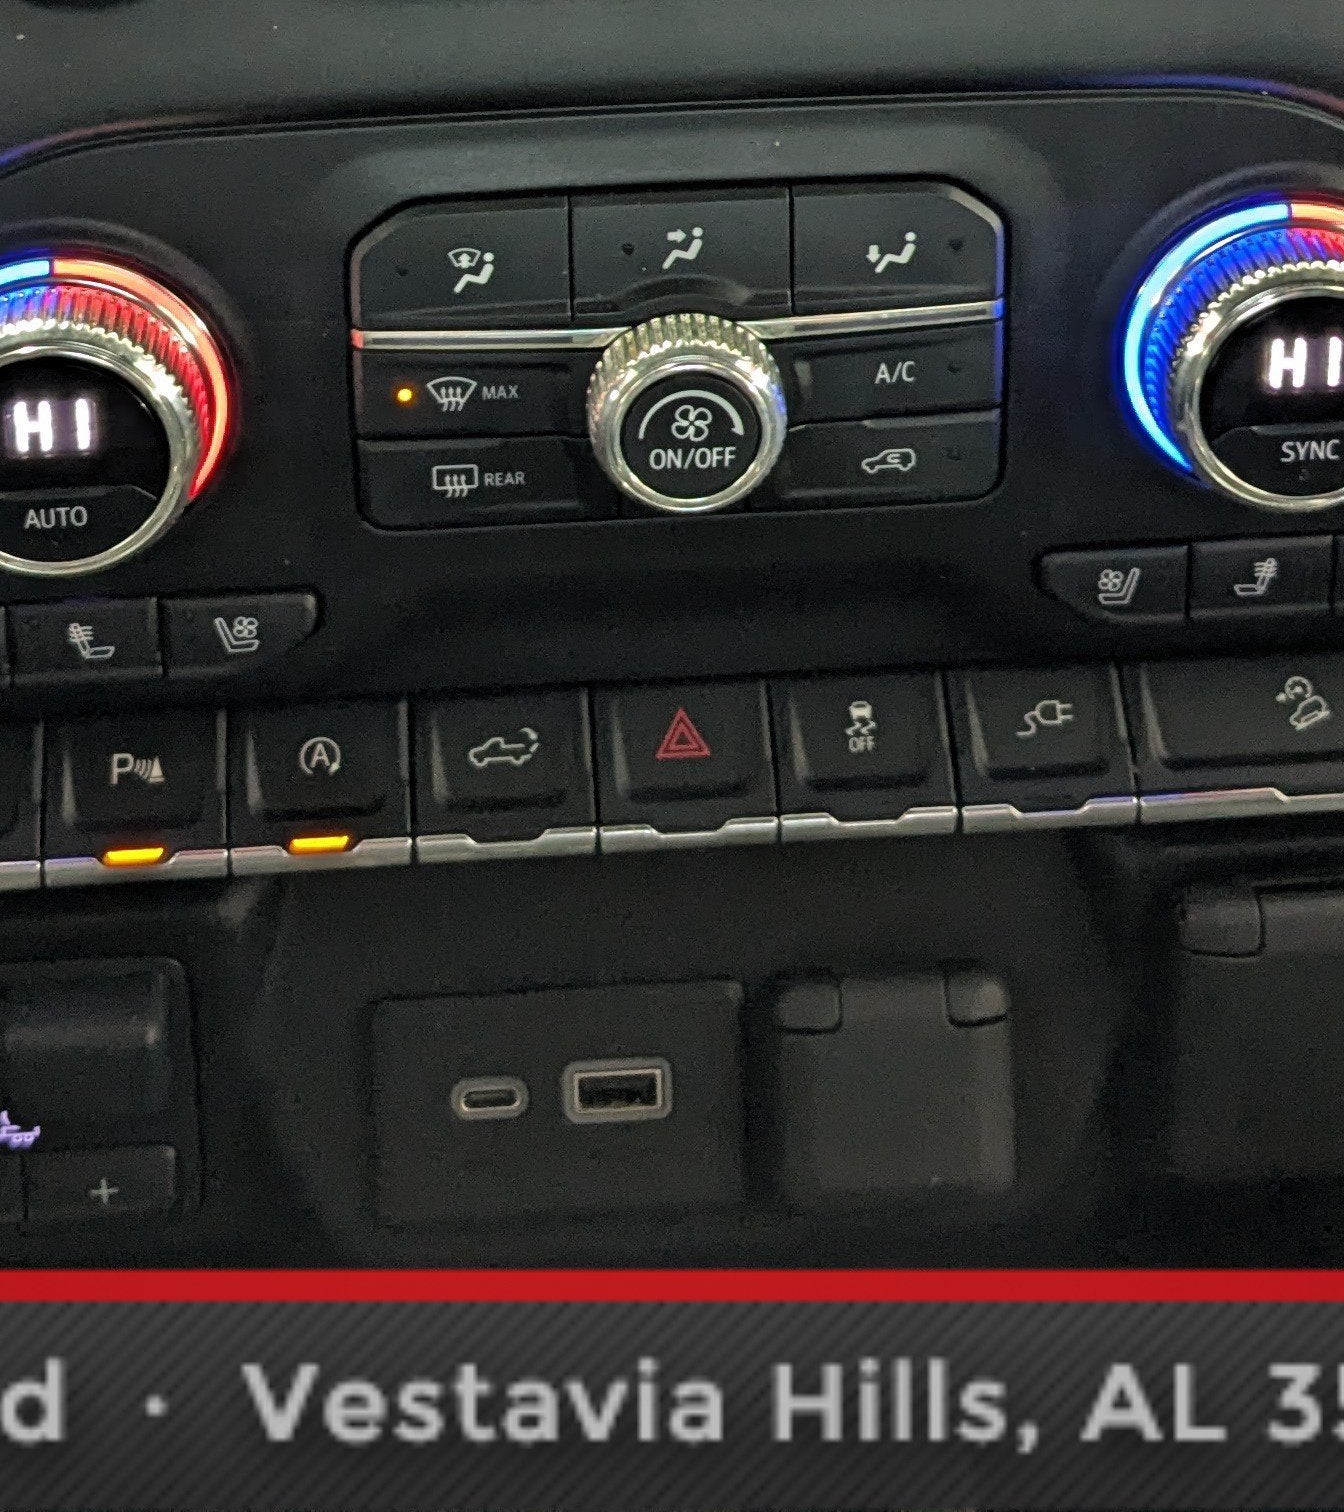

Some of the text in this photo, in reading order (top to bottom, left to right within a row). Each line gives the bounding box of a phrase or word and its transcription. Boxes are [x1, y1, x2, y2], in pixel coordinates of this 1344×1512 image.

[874, 361, 916, 386] A/C
[1268, 335, 1341, 389] HI
[482, 383, 520, 402] MAX
[11, 397, 93, 453] HI
[648, 446, 737, 472] ON/OFF
[1280, 438, 1341, 463] SYNC
[484, 469, 526, 487] REAR
[23, 505, 88, 531] AUTO
[848, 735, 875, 753] OFF
